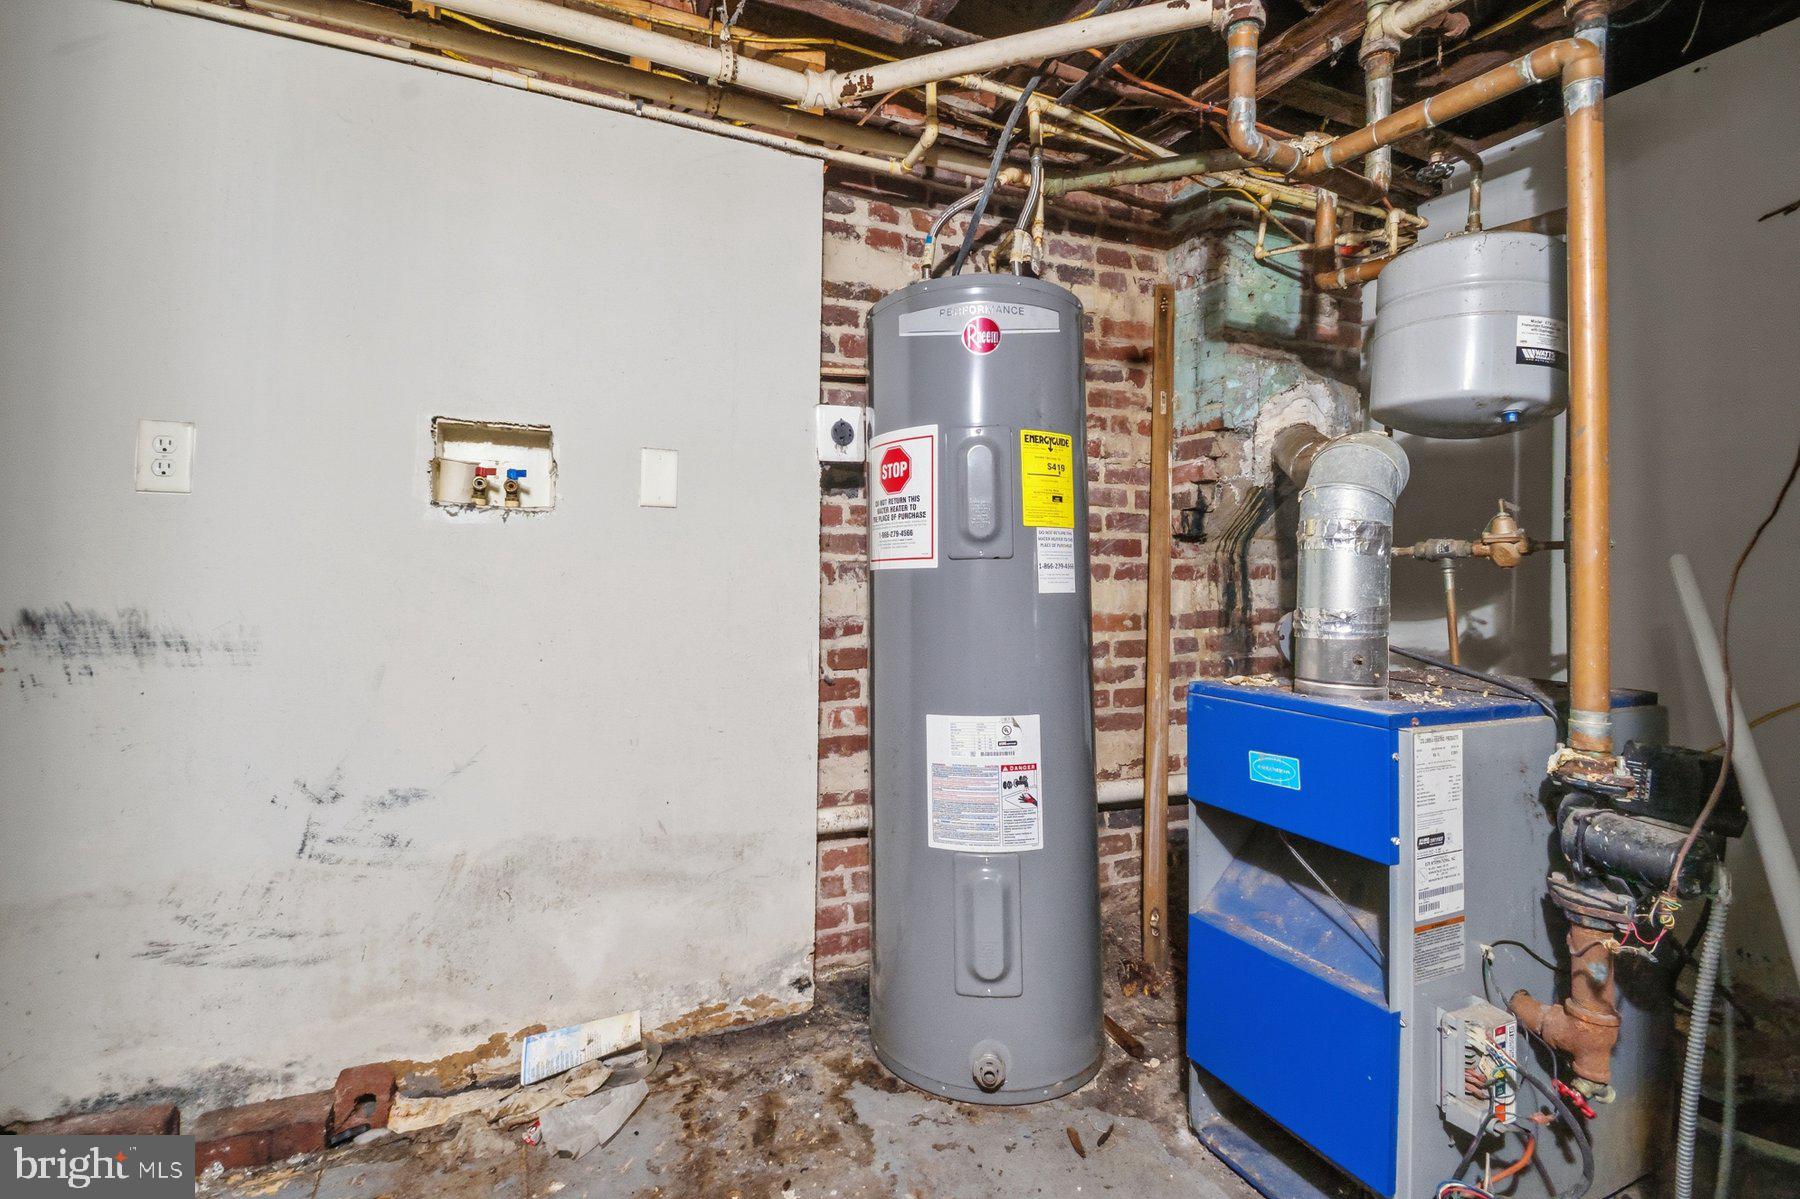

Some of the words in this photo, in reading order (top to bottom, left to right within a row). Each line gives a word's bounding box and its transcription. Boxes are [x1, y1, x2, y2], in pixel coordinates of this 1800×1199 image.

[939, 305, 1024, 317] PERFORMANCE
[966, 322, 1000, 350] Rheem
[882, 461, 908, 480] STOP
[908, 495, 920, 503] THIS
[898, 511, 926, 520] PURCHASE
